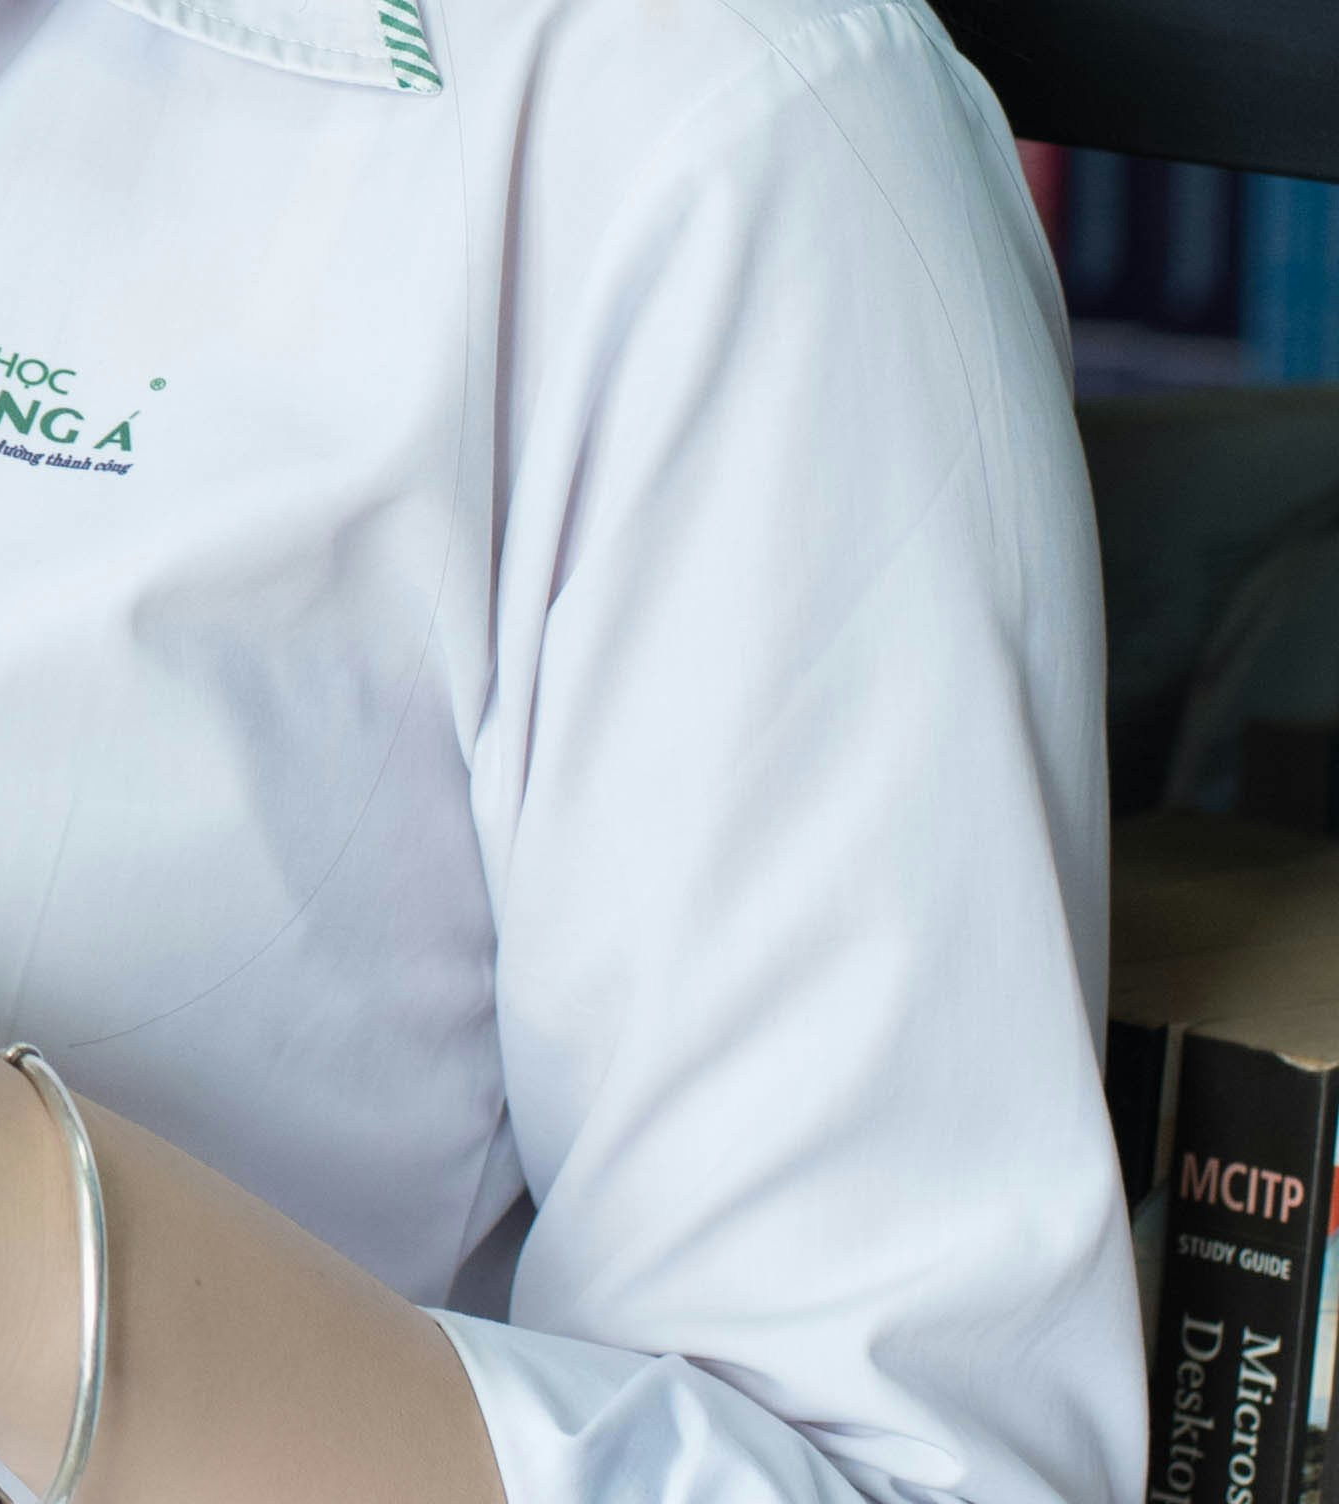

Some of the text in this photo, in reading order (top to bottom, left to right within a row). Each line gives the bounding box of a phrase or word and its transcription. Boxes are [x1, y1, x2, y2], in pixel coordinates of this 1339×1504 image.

[94, 410, 142, 452] Á
[1180, 1151, 1306, 1224] MCITP
[1178, 1233, 1293, 1282] STUDY GUIDE
